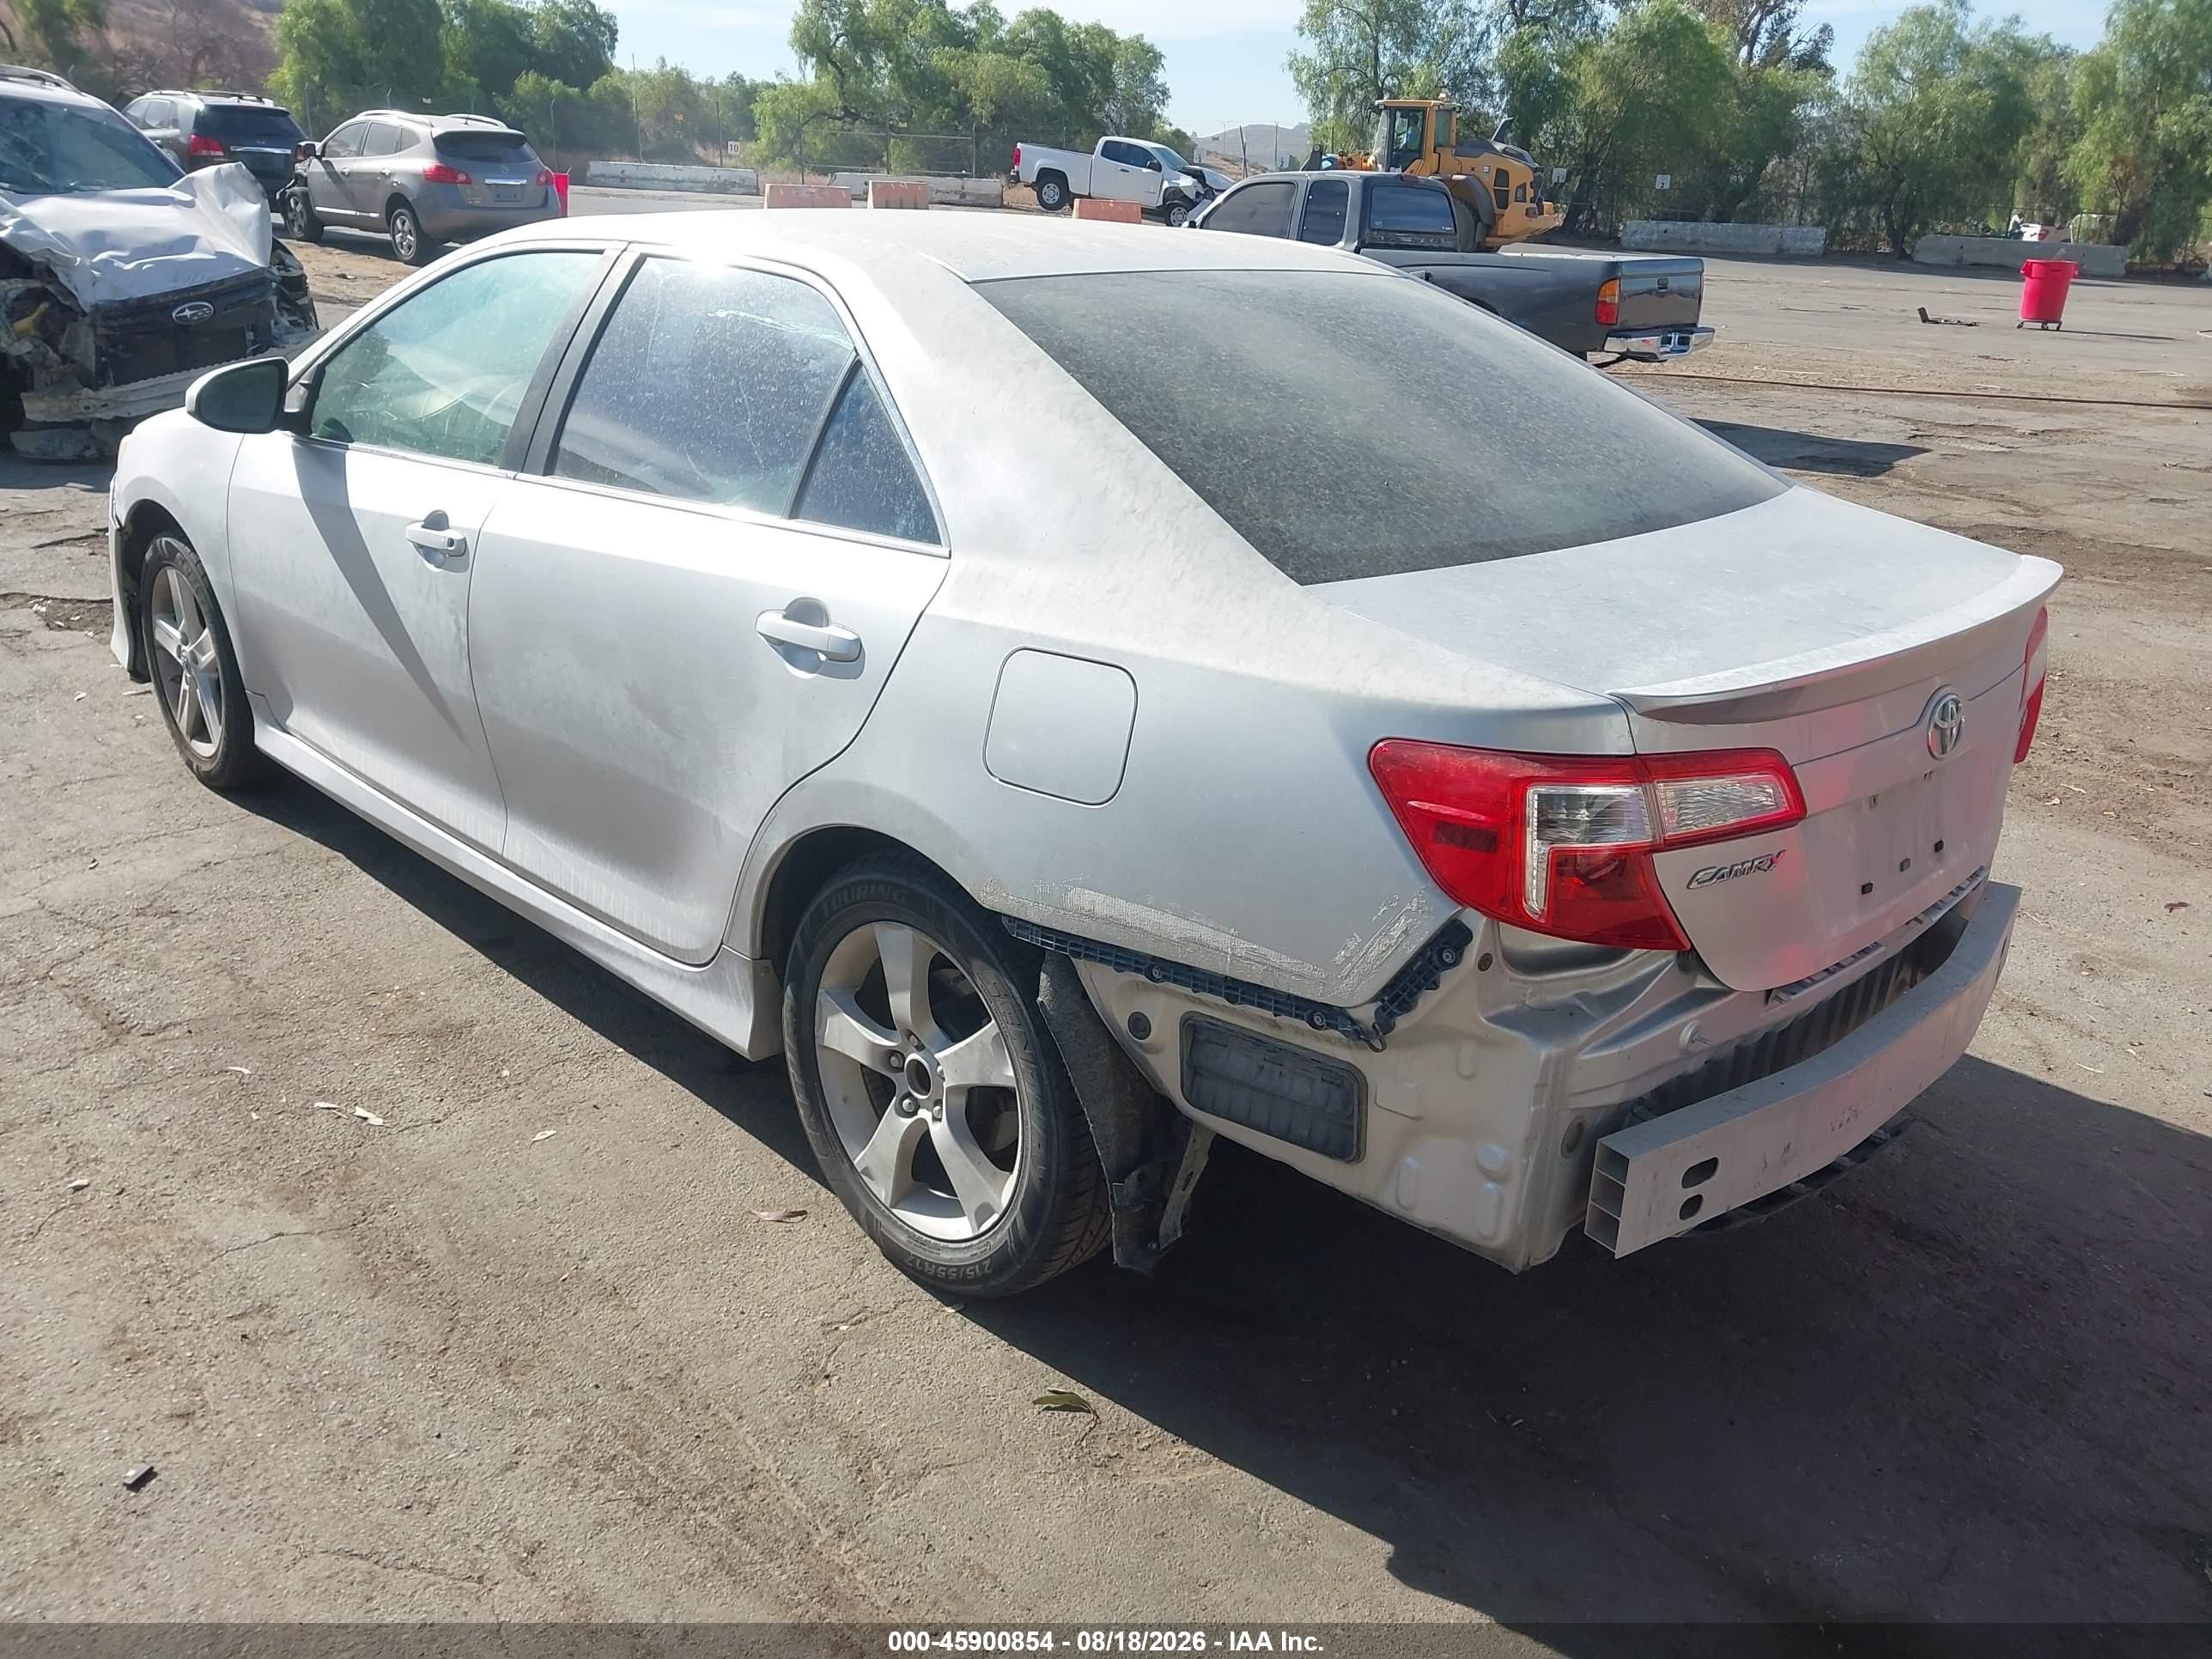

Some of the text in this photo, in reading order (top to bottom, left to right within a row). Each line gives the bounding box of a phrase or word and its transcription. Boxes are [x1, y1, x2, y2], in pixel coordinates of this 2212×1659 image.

[729, 143, 739, 153] 10
[1686, 849, 1786, 890] CAMRY
[819, 884, 907, 918] TOURING
[904, 1252, 992, 1280] 215/55R17
